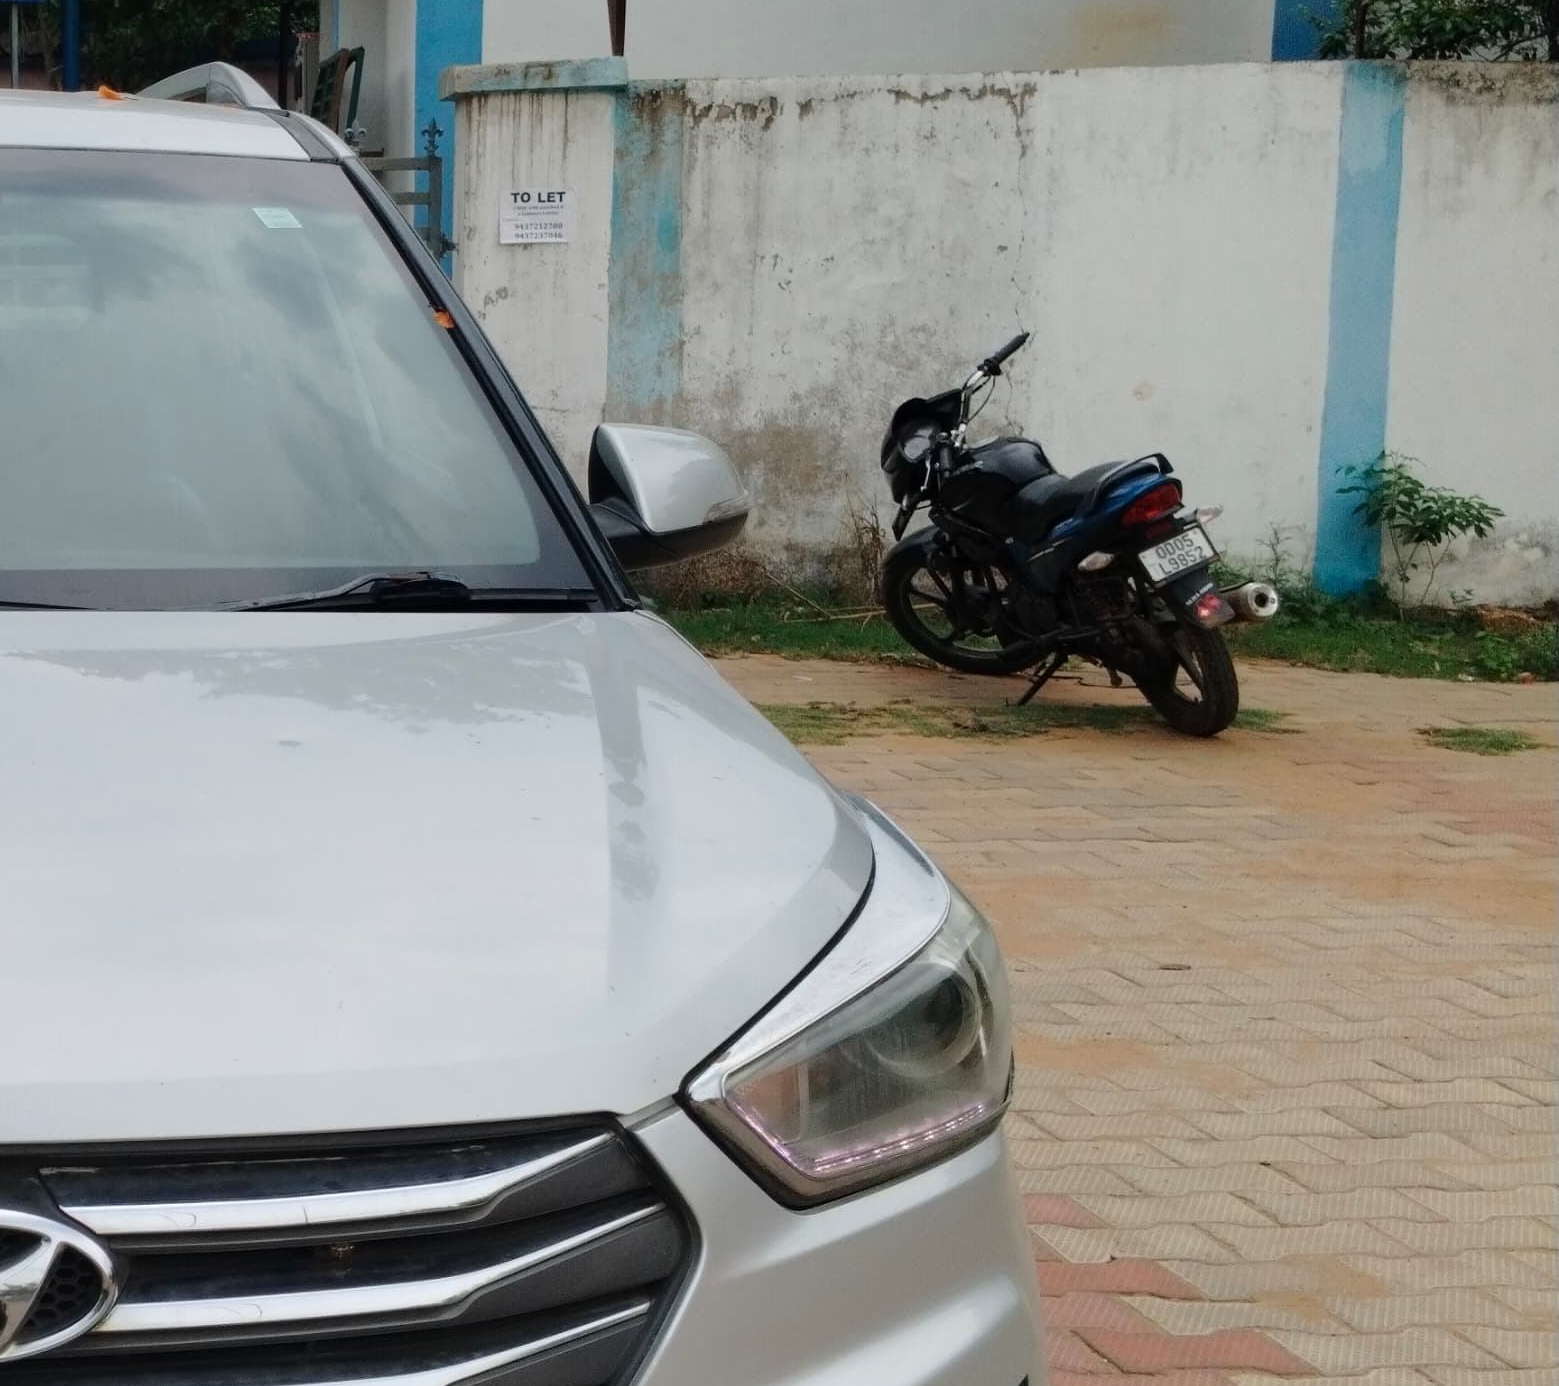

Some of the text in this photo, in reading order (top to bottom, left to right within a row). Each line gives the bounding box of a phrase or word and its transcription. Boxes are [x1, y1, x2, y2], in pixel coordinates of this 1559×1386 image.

[510, 191, 566, 204] TO LET
[1155, 533, 1195, 559] OD05
[1159, 545, 1208, 575] L9852
